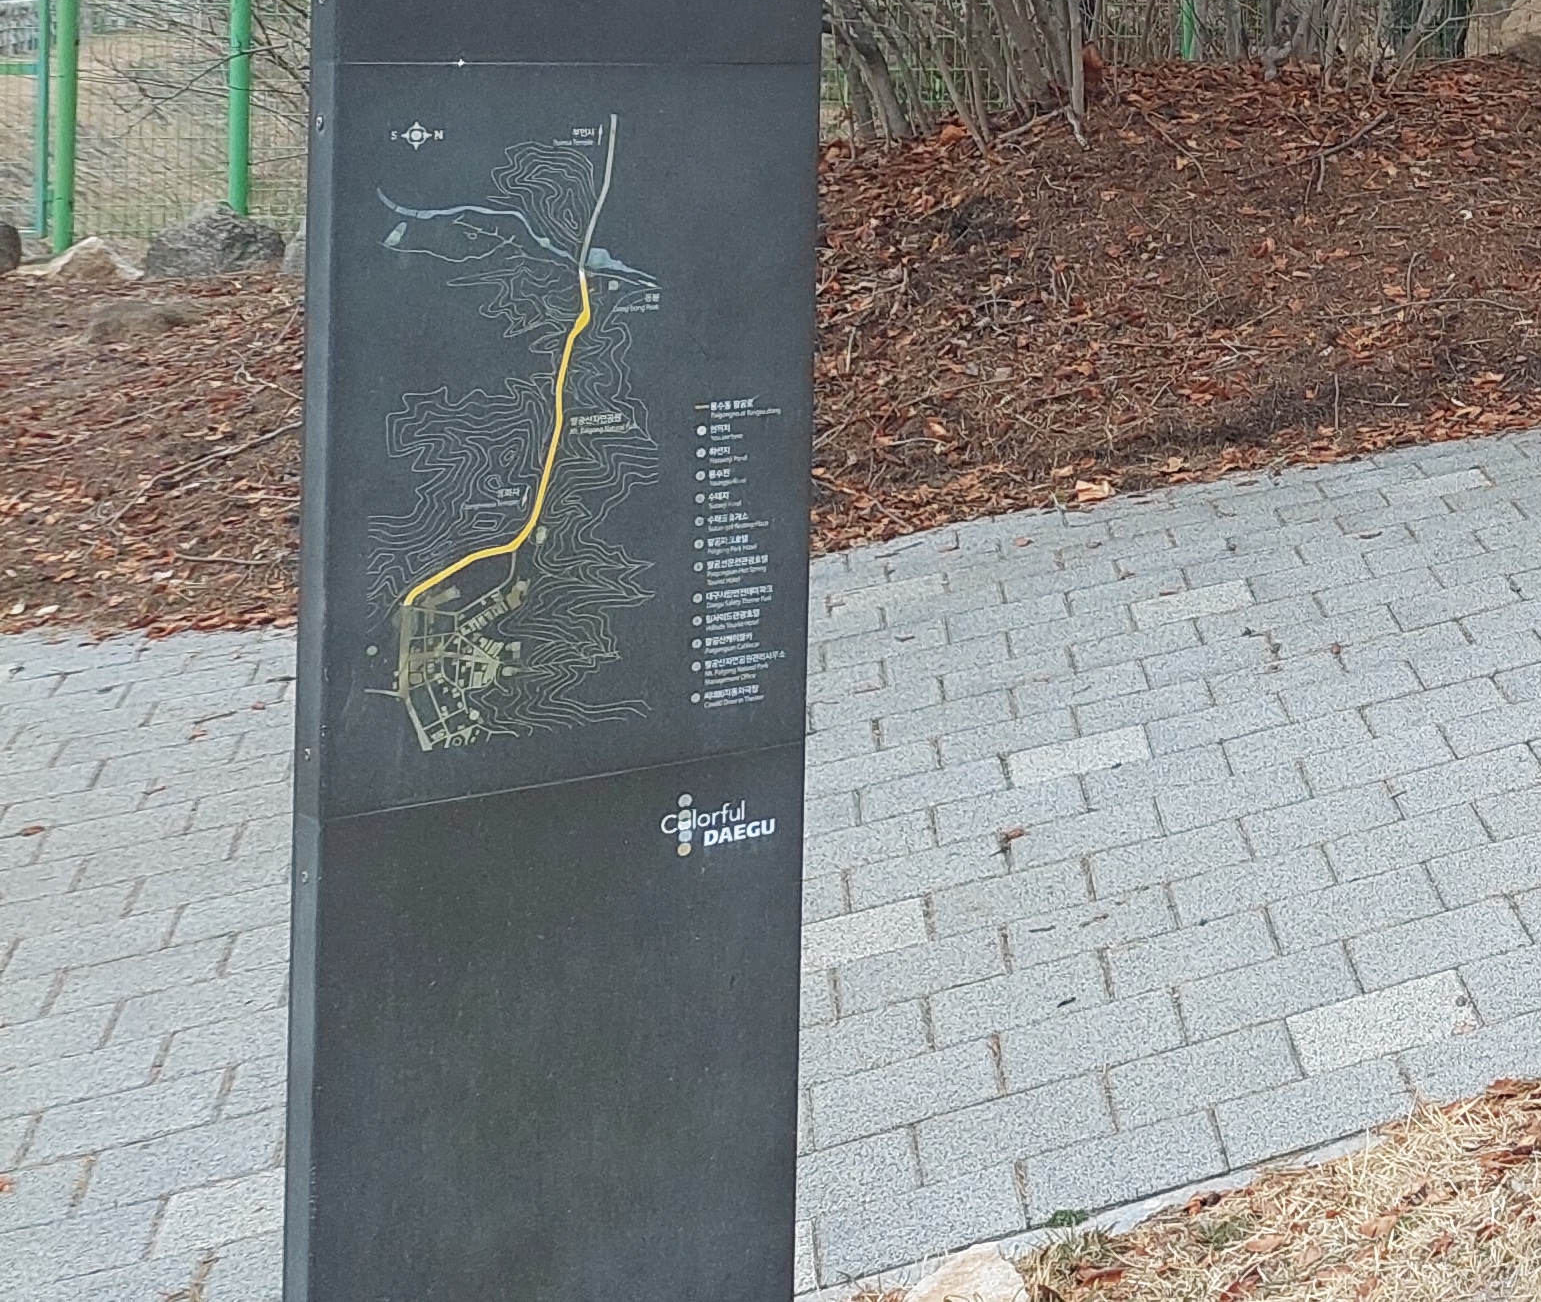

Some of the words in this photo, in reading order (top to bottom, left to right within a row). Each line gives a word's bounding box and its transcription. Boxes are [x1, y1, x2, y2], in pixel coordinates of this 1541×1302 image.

[434, 130, 444, 140] N
[660, 799, 746, 834] Colorful
[704, 818, 776, 847] DAEGU
